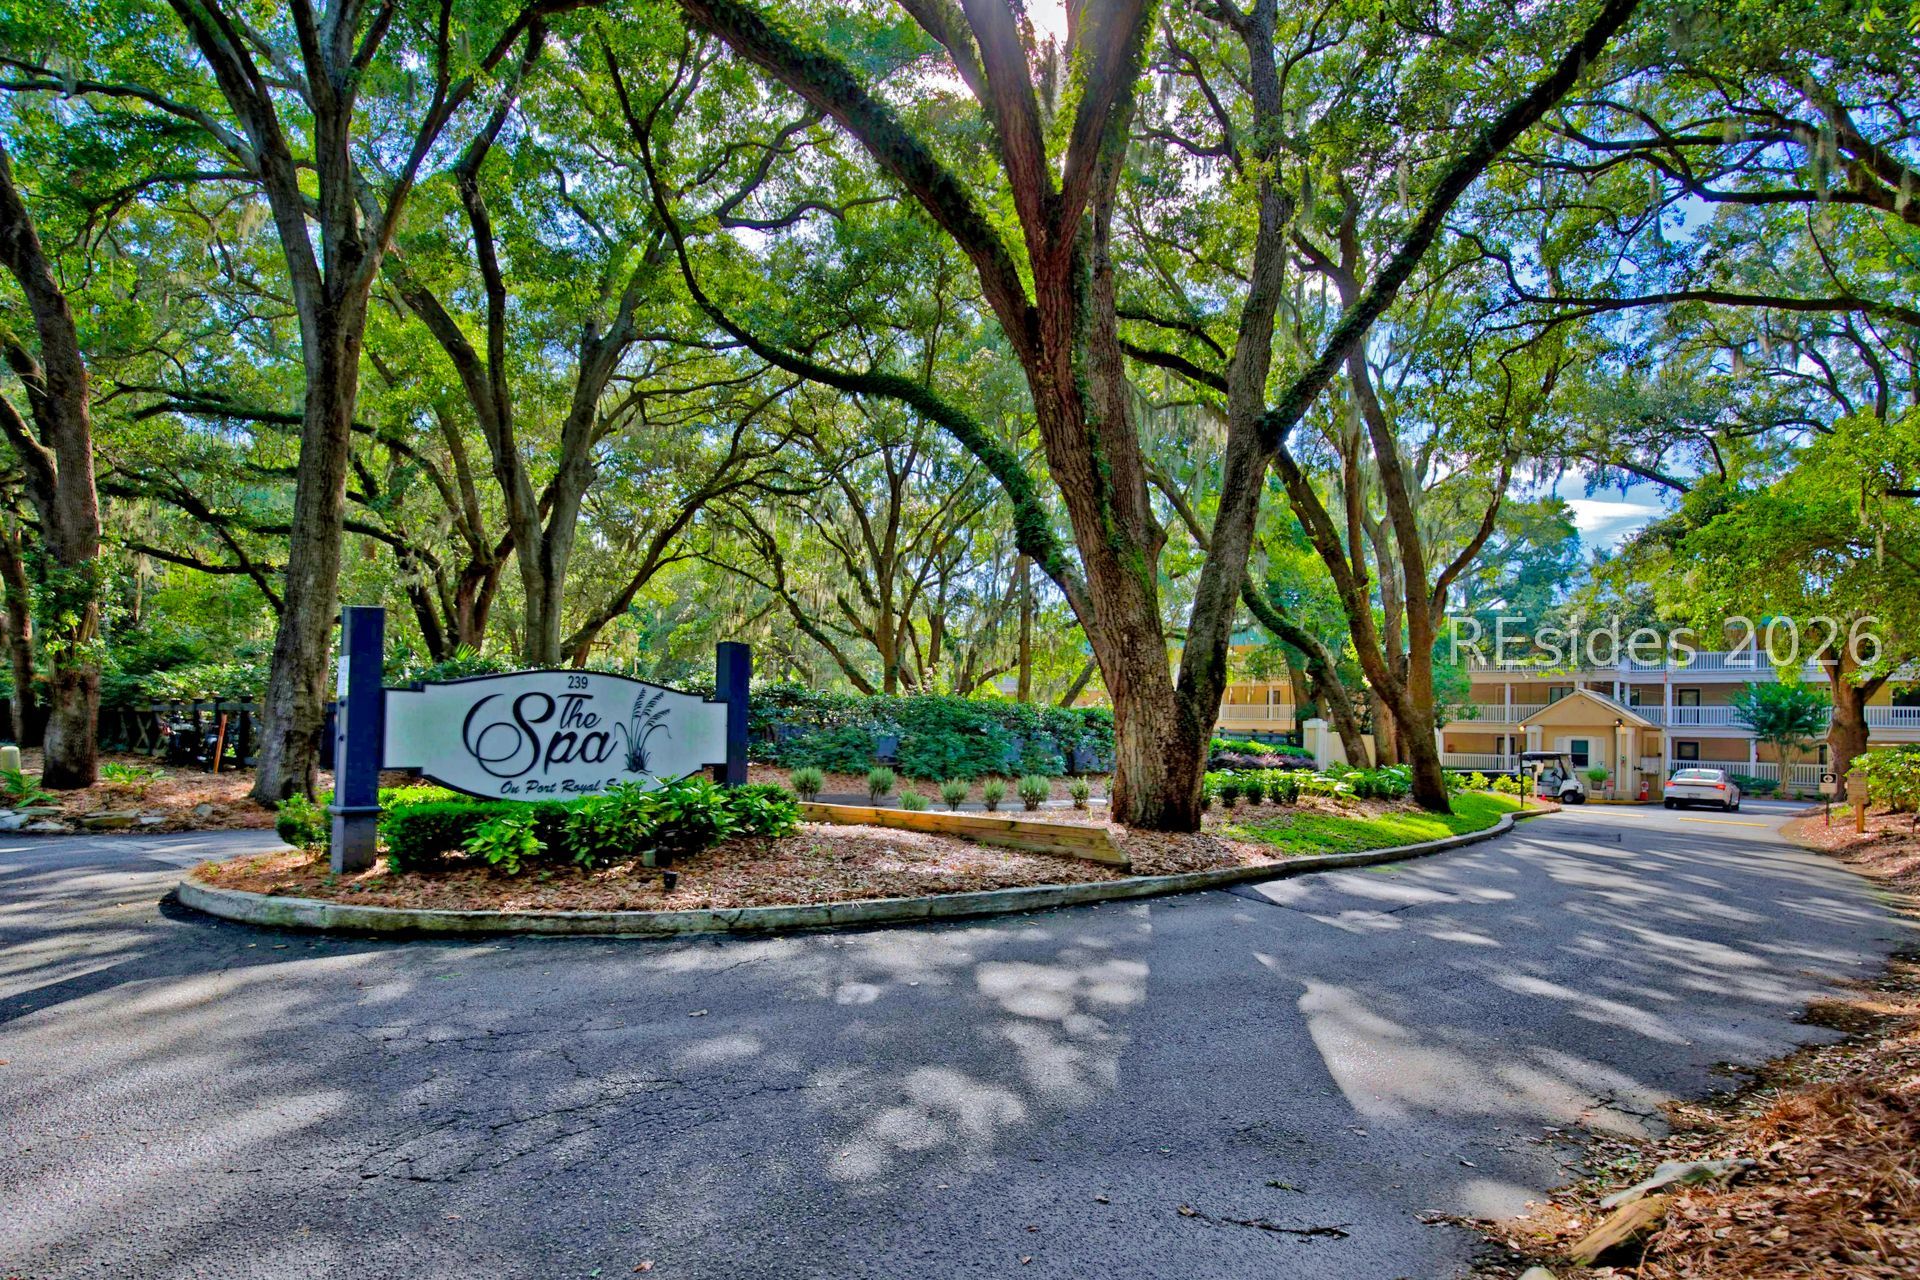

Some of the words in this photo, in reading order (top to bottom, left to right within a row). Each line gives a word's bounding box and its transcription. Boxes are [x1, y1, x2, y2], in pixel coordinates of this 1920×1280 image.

[567, 675, 588, 689] 239
[557, 693, 602, 729] The
[462, 691, 618, 778] Spa
[500, 780, 520, 794] On
[525, 779, 557, 794] Port
[561, 779, 601, 795] Royal
